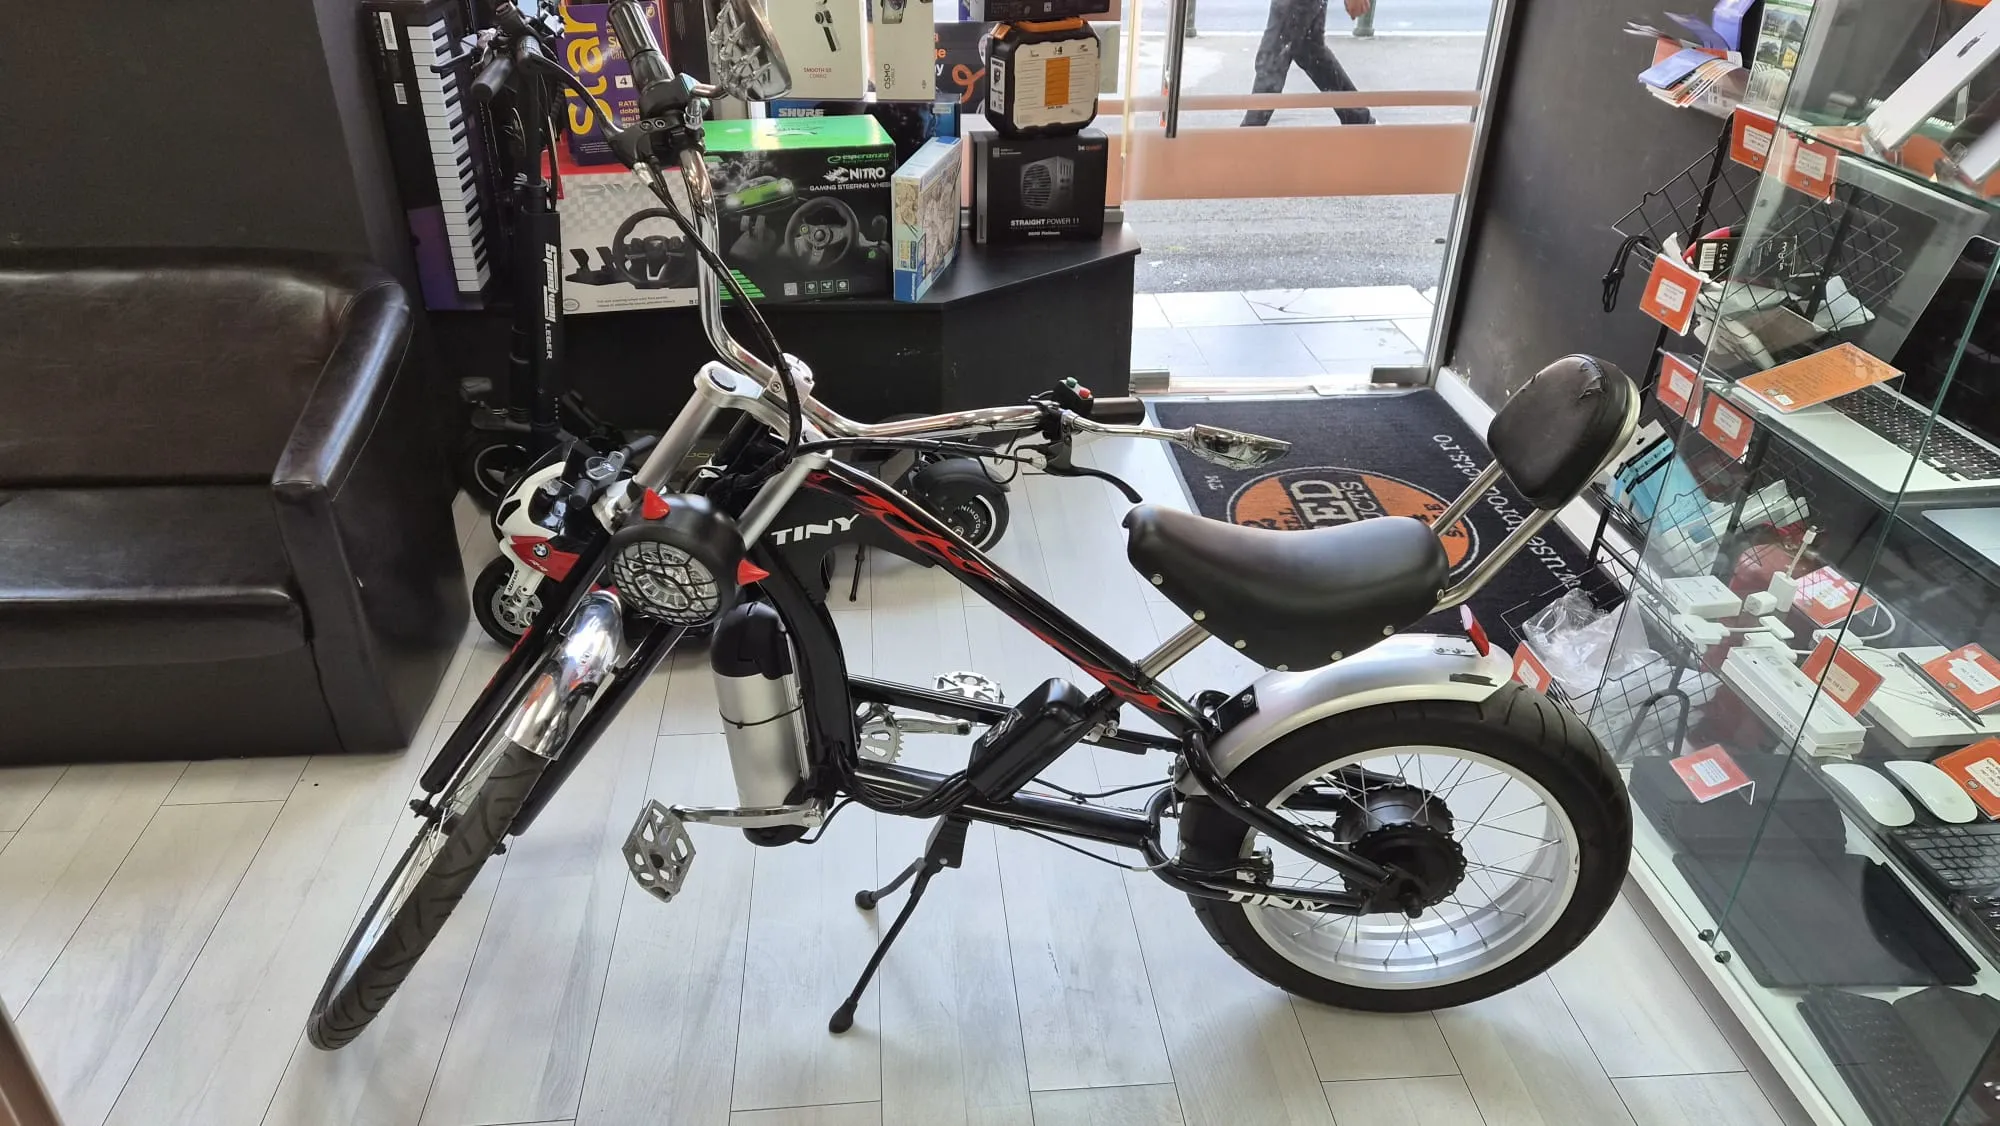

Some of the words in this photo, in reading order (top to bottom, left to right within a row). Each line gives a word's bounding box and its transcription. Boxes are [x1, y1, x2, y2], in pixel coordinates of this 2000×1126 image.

[883, 63, 891, 90] OSMO
[778, 108, 825, 117] SHURE
[848, 167, 887, 180] NITRO
[837, 183, 870, 191] STEERING
[1046, 217, 1071, 225] POWER
[544, 323, 553, 360] LEGER
[771, 513, 859, 546] TINY
